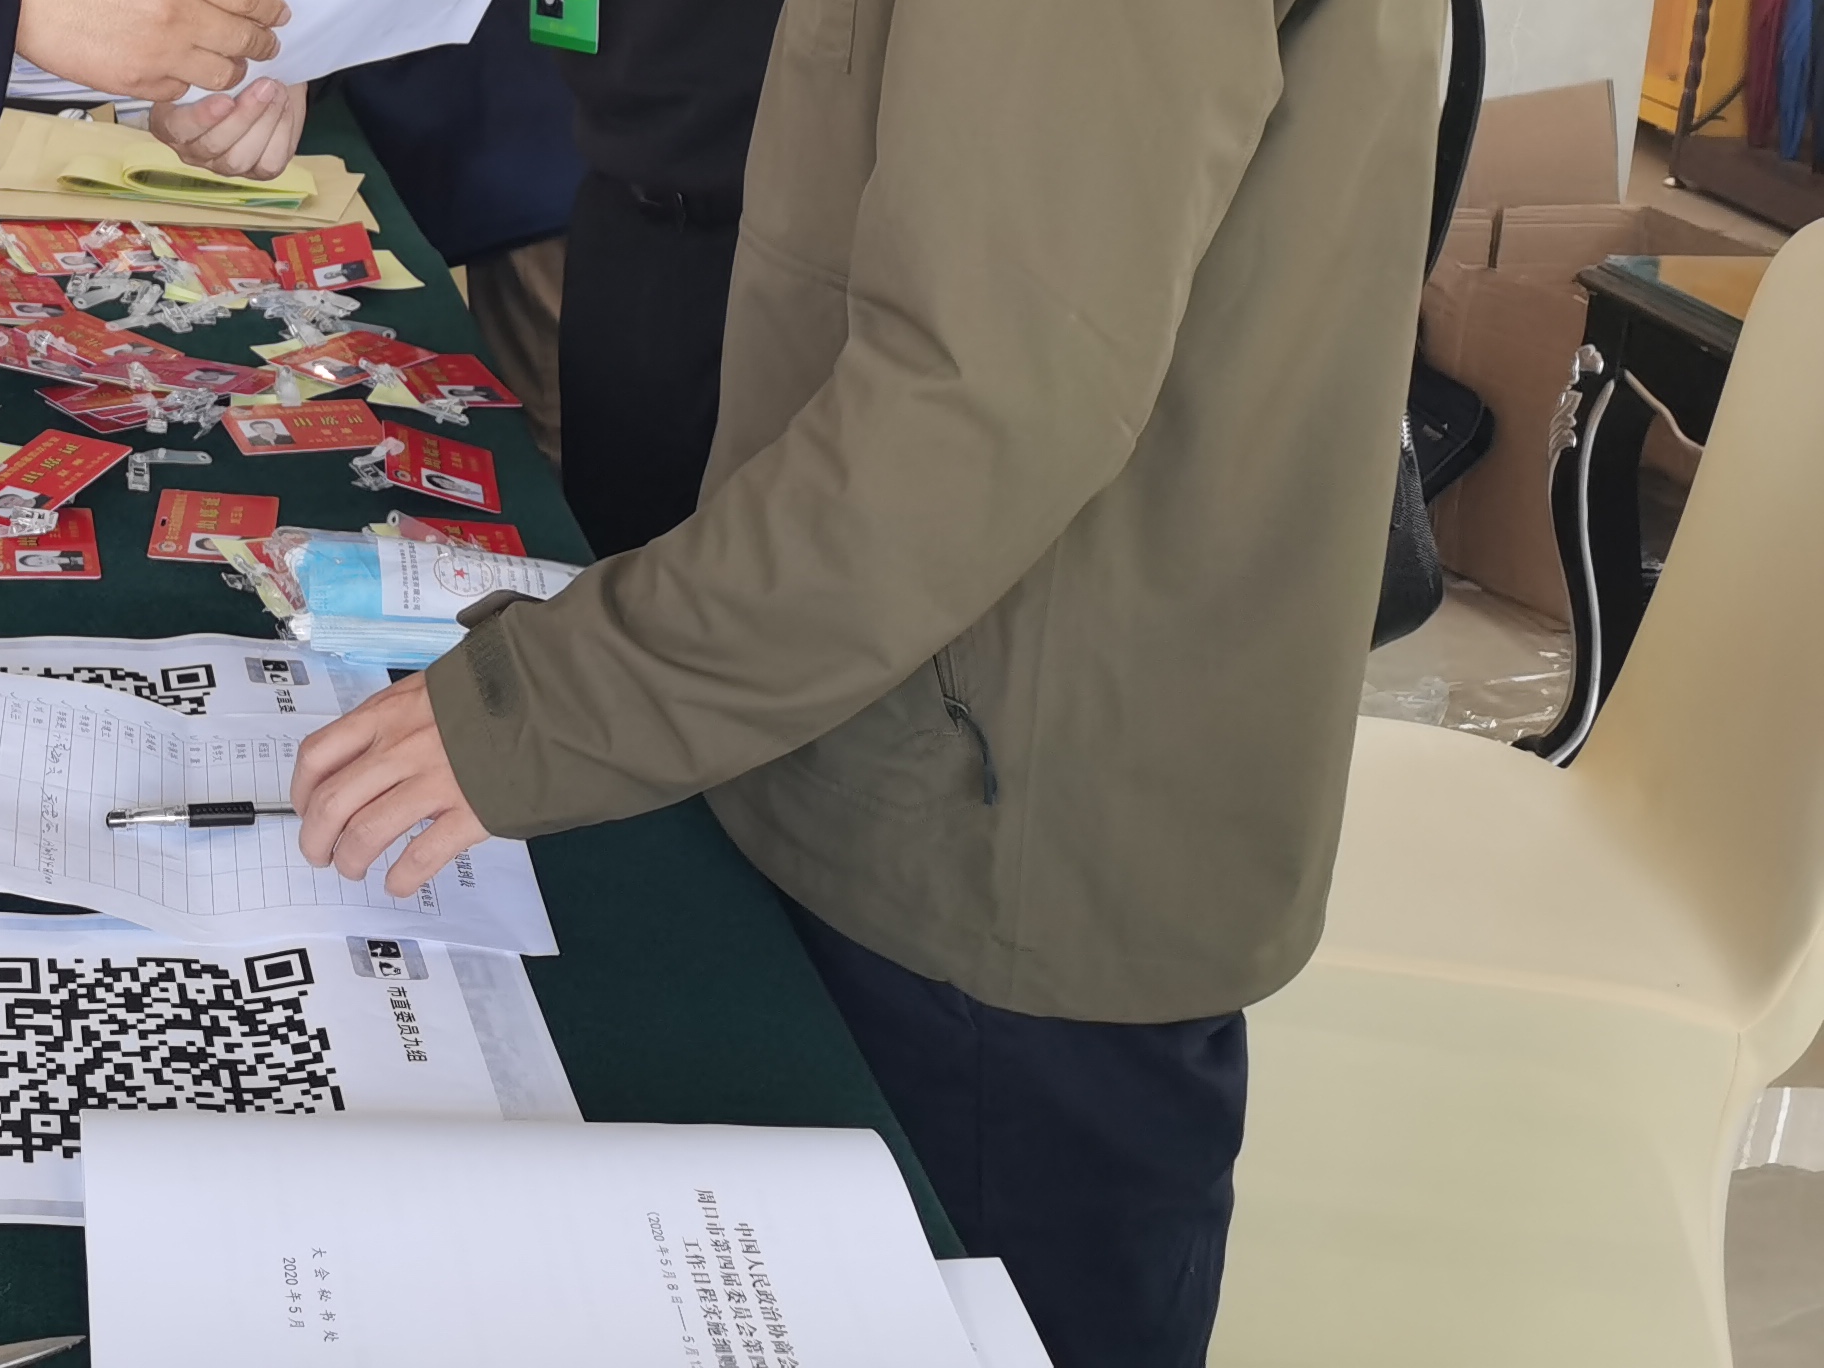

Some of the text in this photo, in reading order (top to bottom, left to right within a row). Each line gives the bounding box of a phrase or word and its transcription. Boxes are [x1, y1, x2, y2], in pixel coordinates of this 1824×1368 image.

[386, 985, 428, 1062] 市直委员九组
[282, 1257, 305, 1328] 2020年5月
[311, 1247, 339, 1342] 大会秘书处
